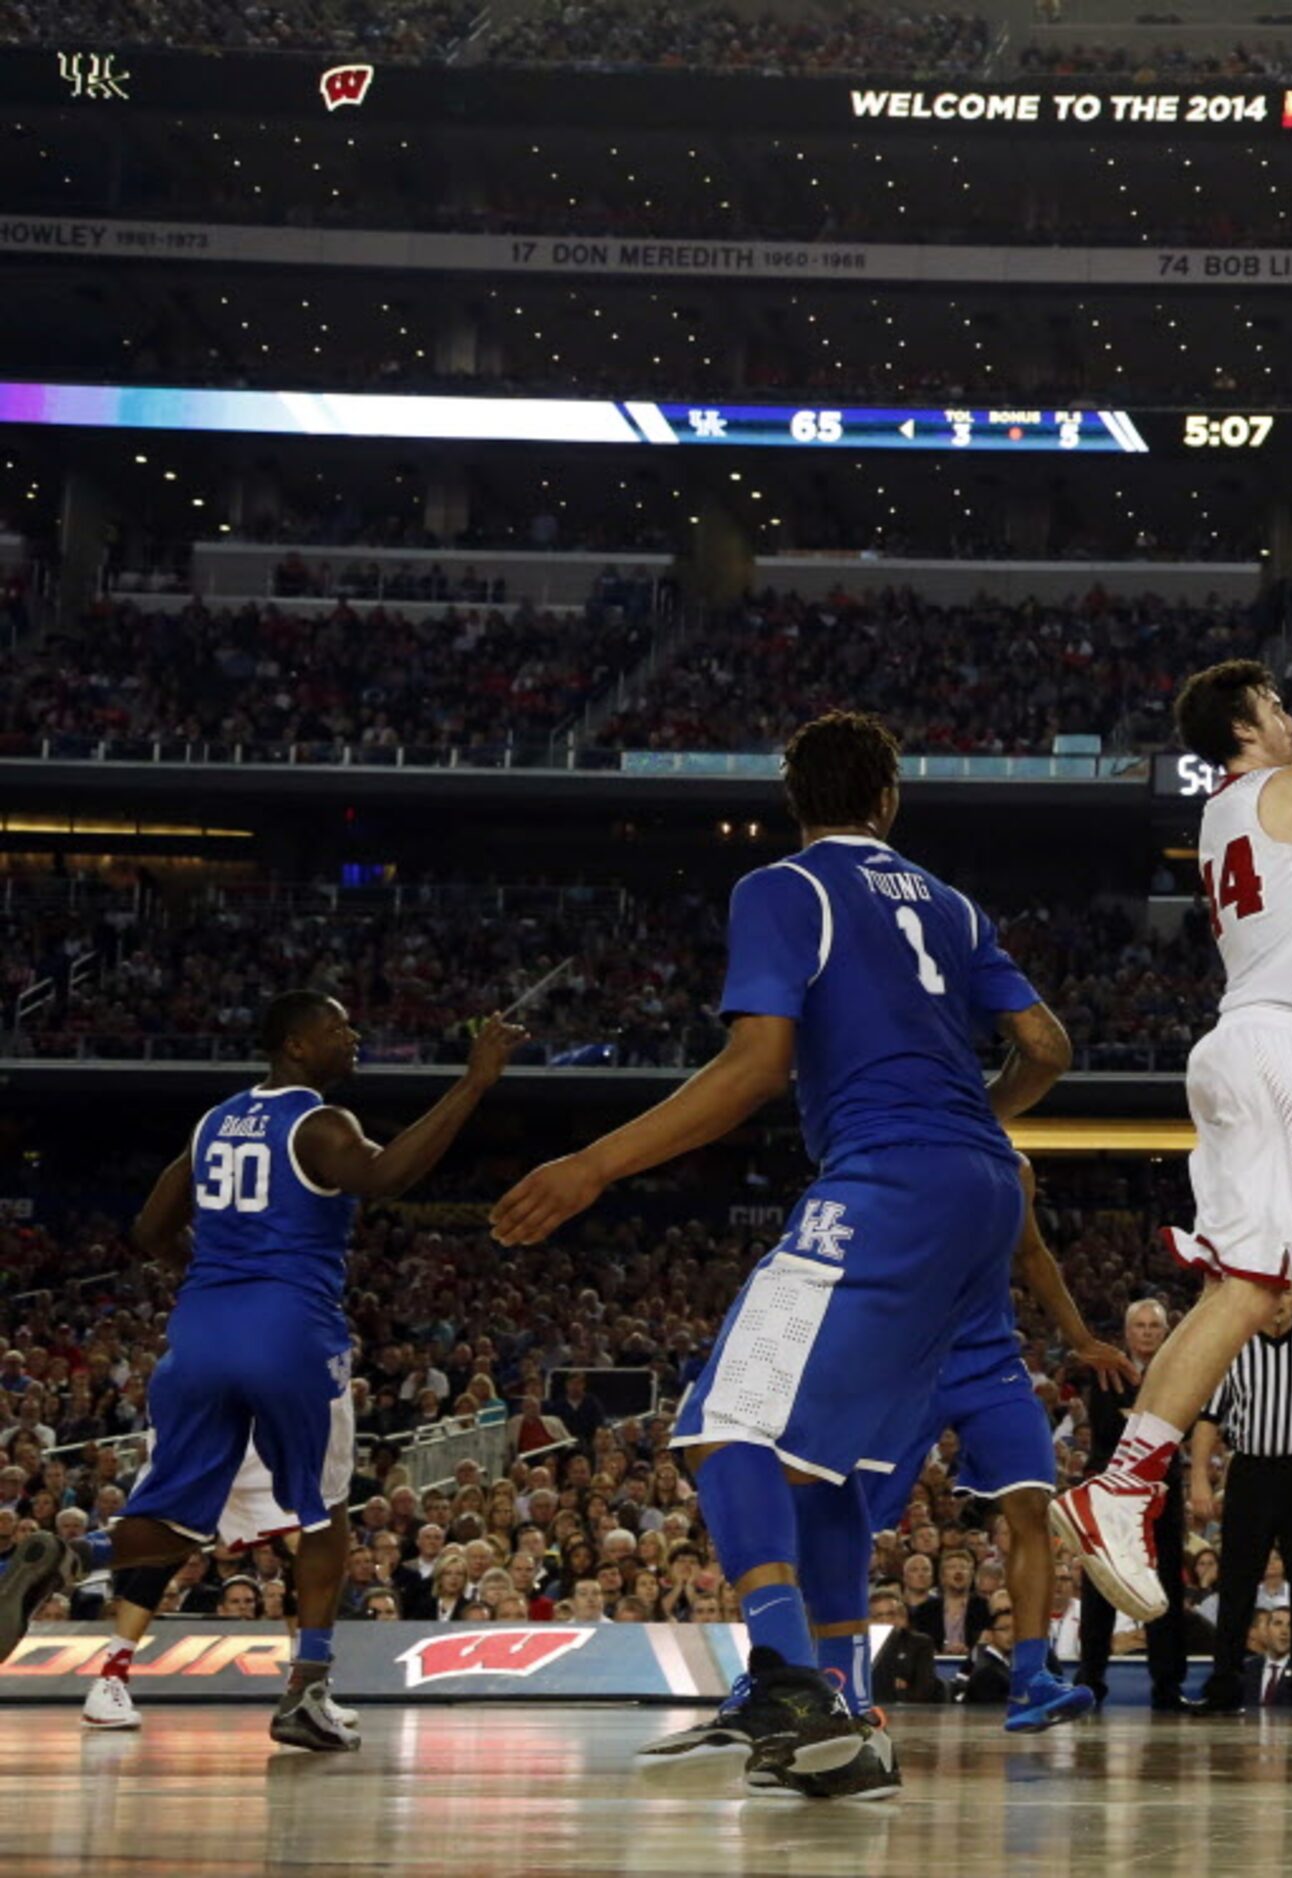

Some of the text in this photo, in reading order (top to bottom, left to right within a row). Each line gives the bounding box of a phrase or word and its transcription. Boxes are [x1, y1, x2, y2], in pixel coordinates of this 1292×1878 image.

[850, 91, 1040, 120] WELCOME
[1053, 95, 1100, 121] TO
[1110, 95, 1179, 121] THE
[1184, 95, 1267, 121] 2014
[0, 222, 106, 247] HOWLEY
[512, 243, 536, 263] 17
[552, 244, 608, 265] DON
[620, 244, 755, 269] MEREDITH
[1159, 255, 1189, 276] 74
[1204, 255, 1260, 276] BOB
[790, 411, 843, 443] 65
[988, 411, 1041, 423] BONUS
[1183, 415, 1273, 447] 5:07
[951, 423, 971, 447] 3
[856, 865, 932, 902] YOUNG
[895, 905, 946, 995] 1
[196, 1141, 271, 1213] 30
